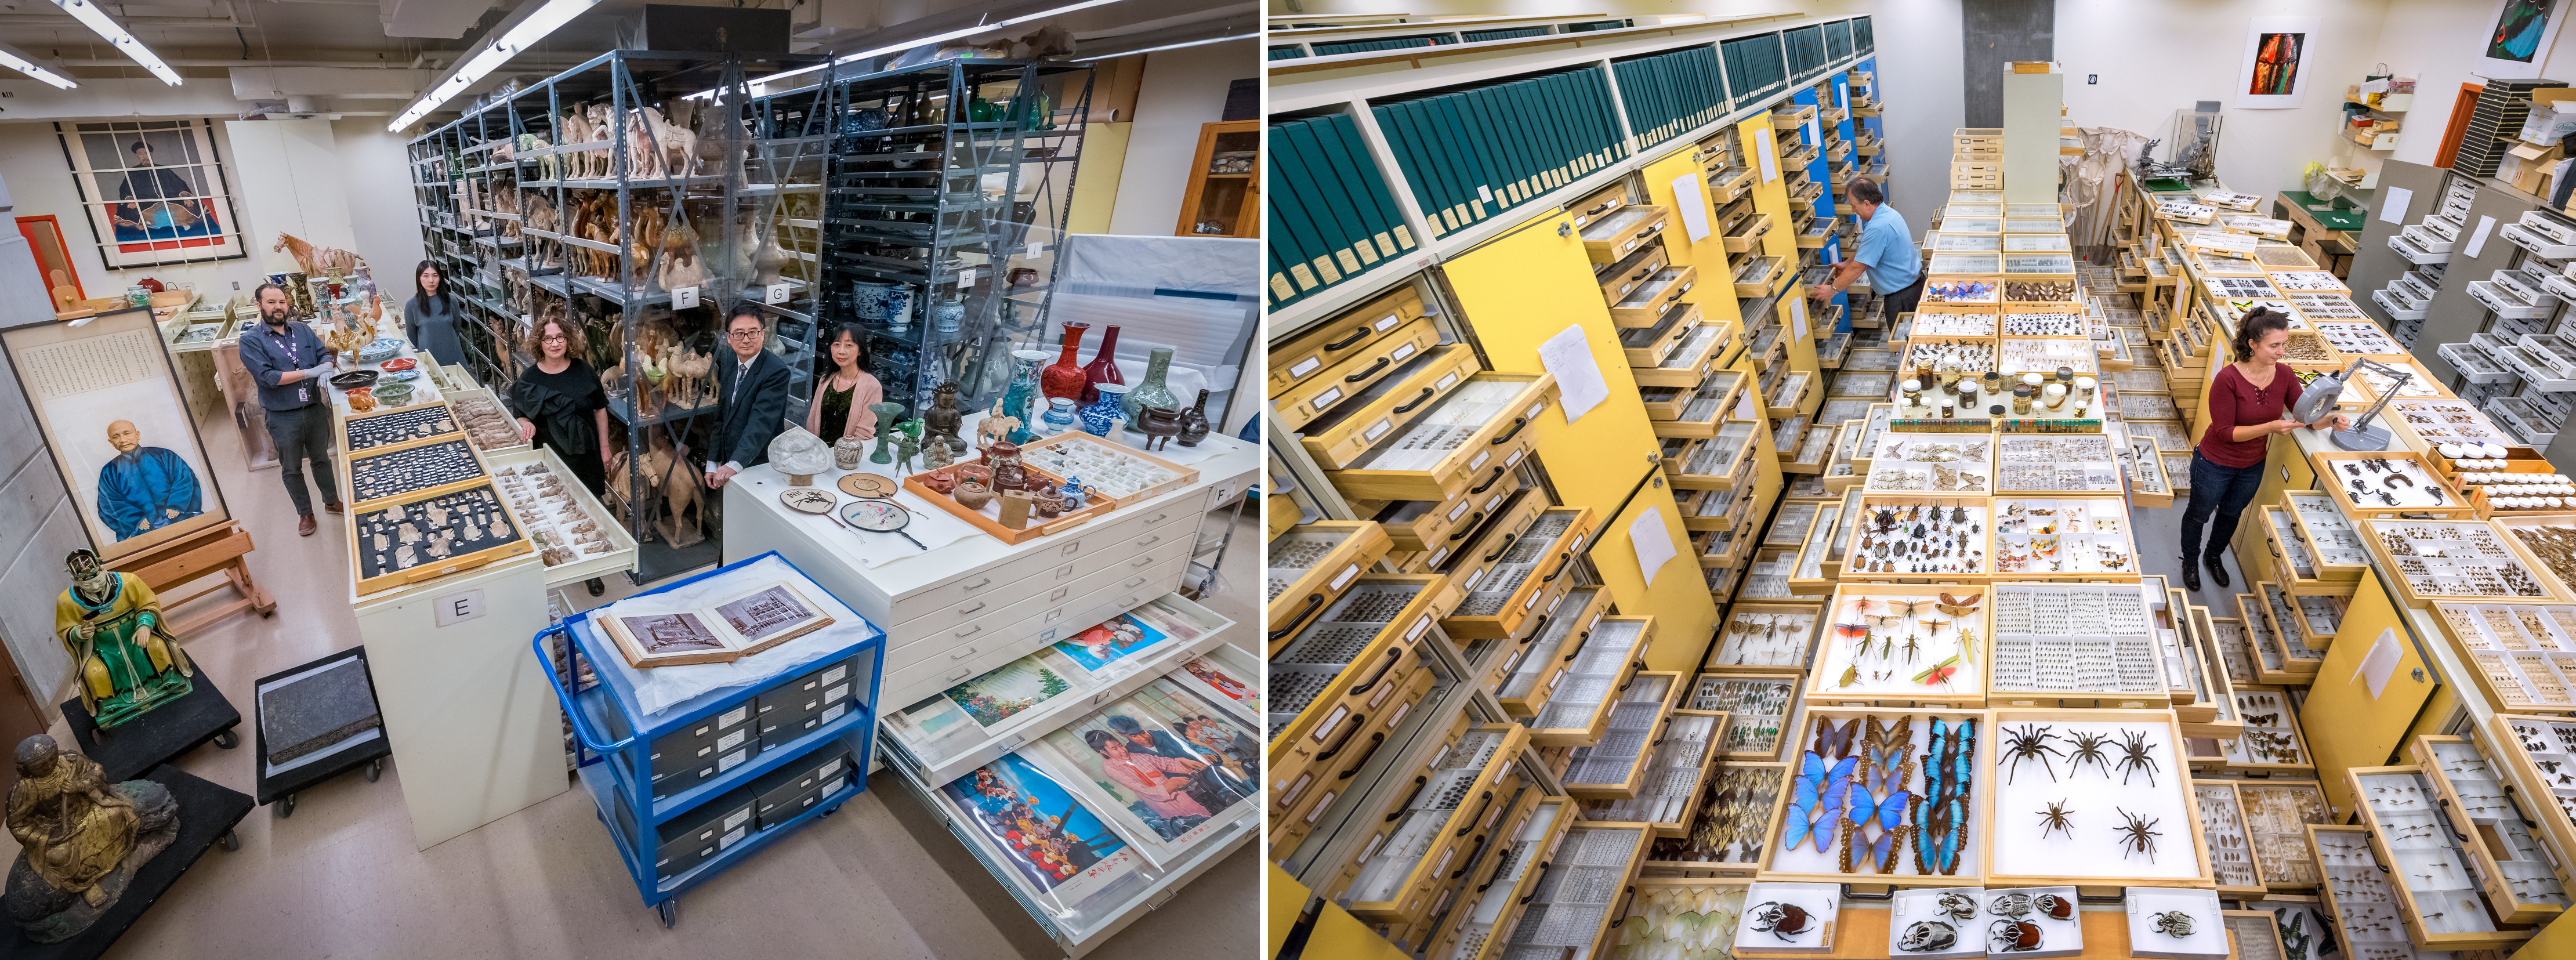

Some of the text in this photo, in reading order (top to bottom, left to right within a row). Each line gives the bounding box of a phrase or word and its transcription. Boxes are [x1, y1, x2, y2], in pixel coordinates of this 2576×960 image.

[965, 274, 970, 284] H
[682, 292, 689, 305] F
[773, 288, 782, 299] G
[1218, 489, 1225, 501] F
[455, 599, 470, 617] E
